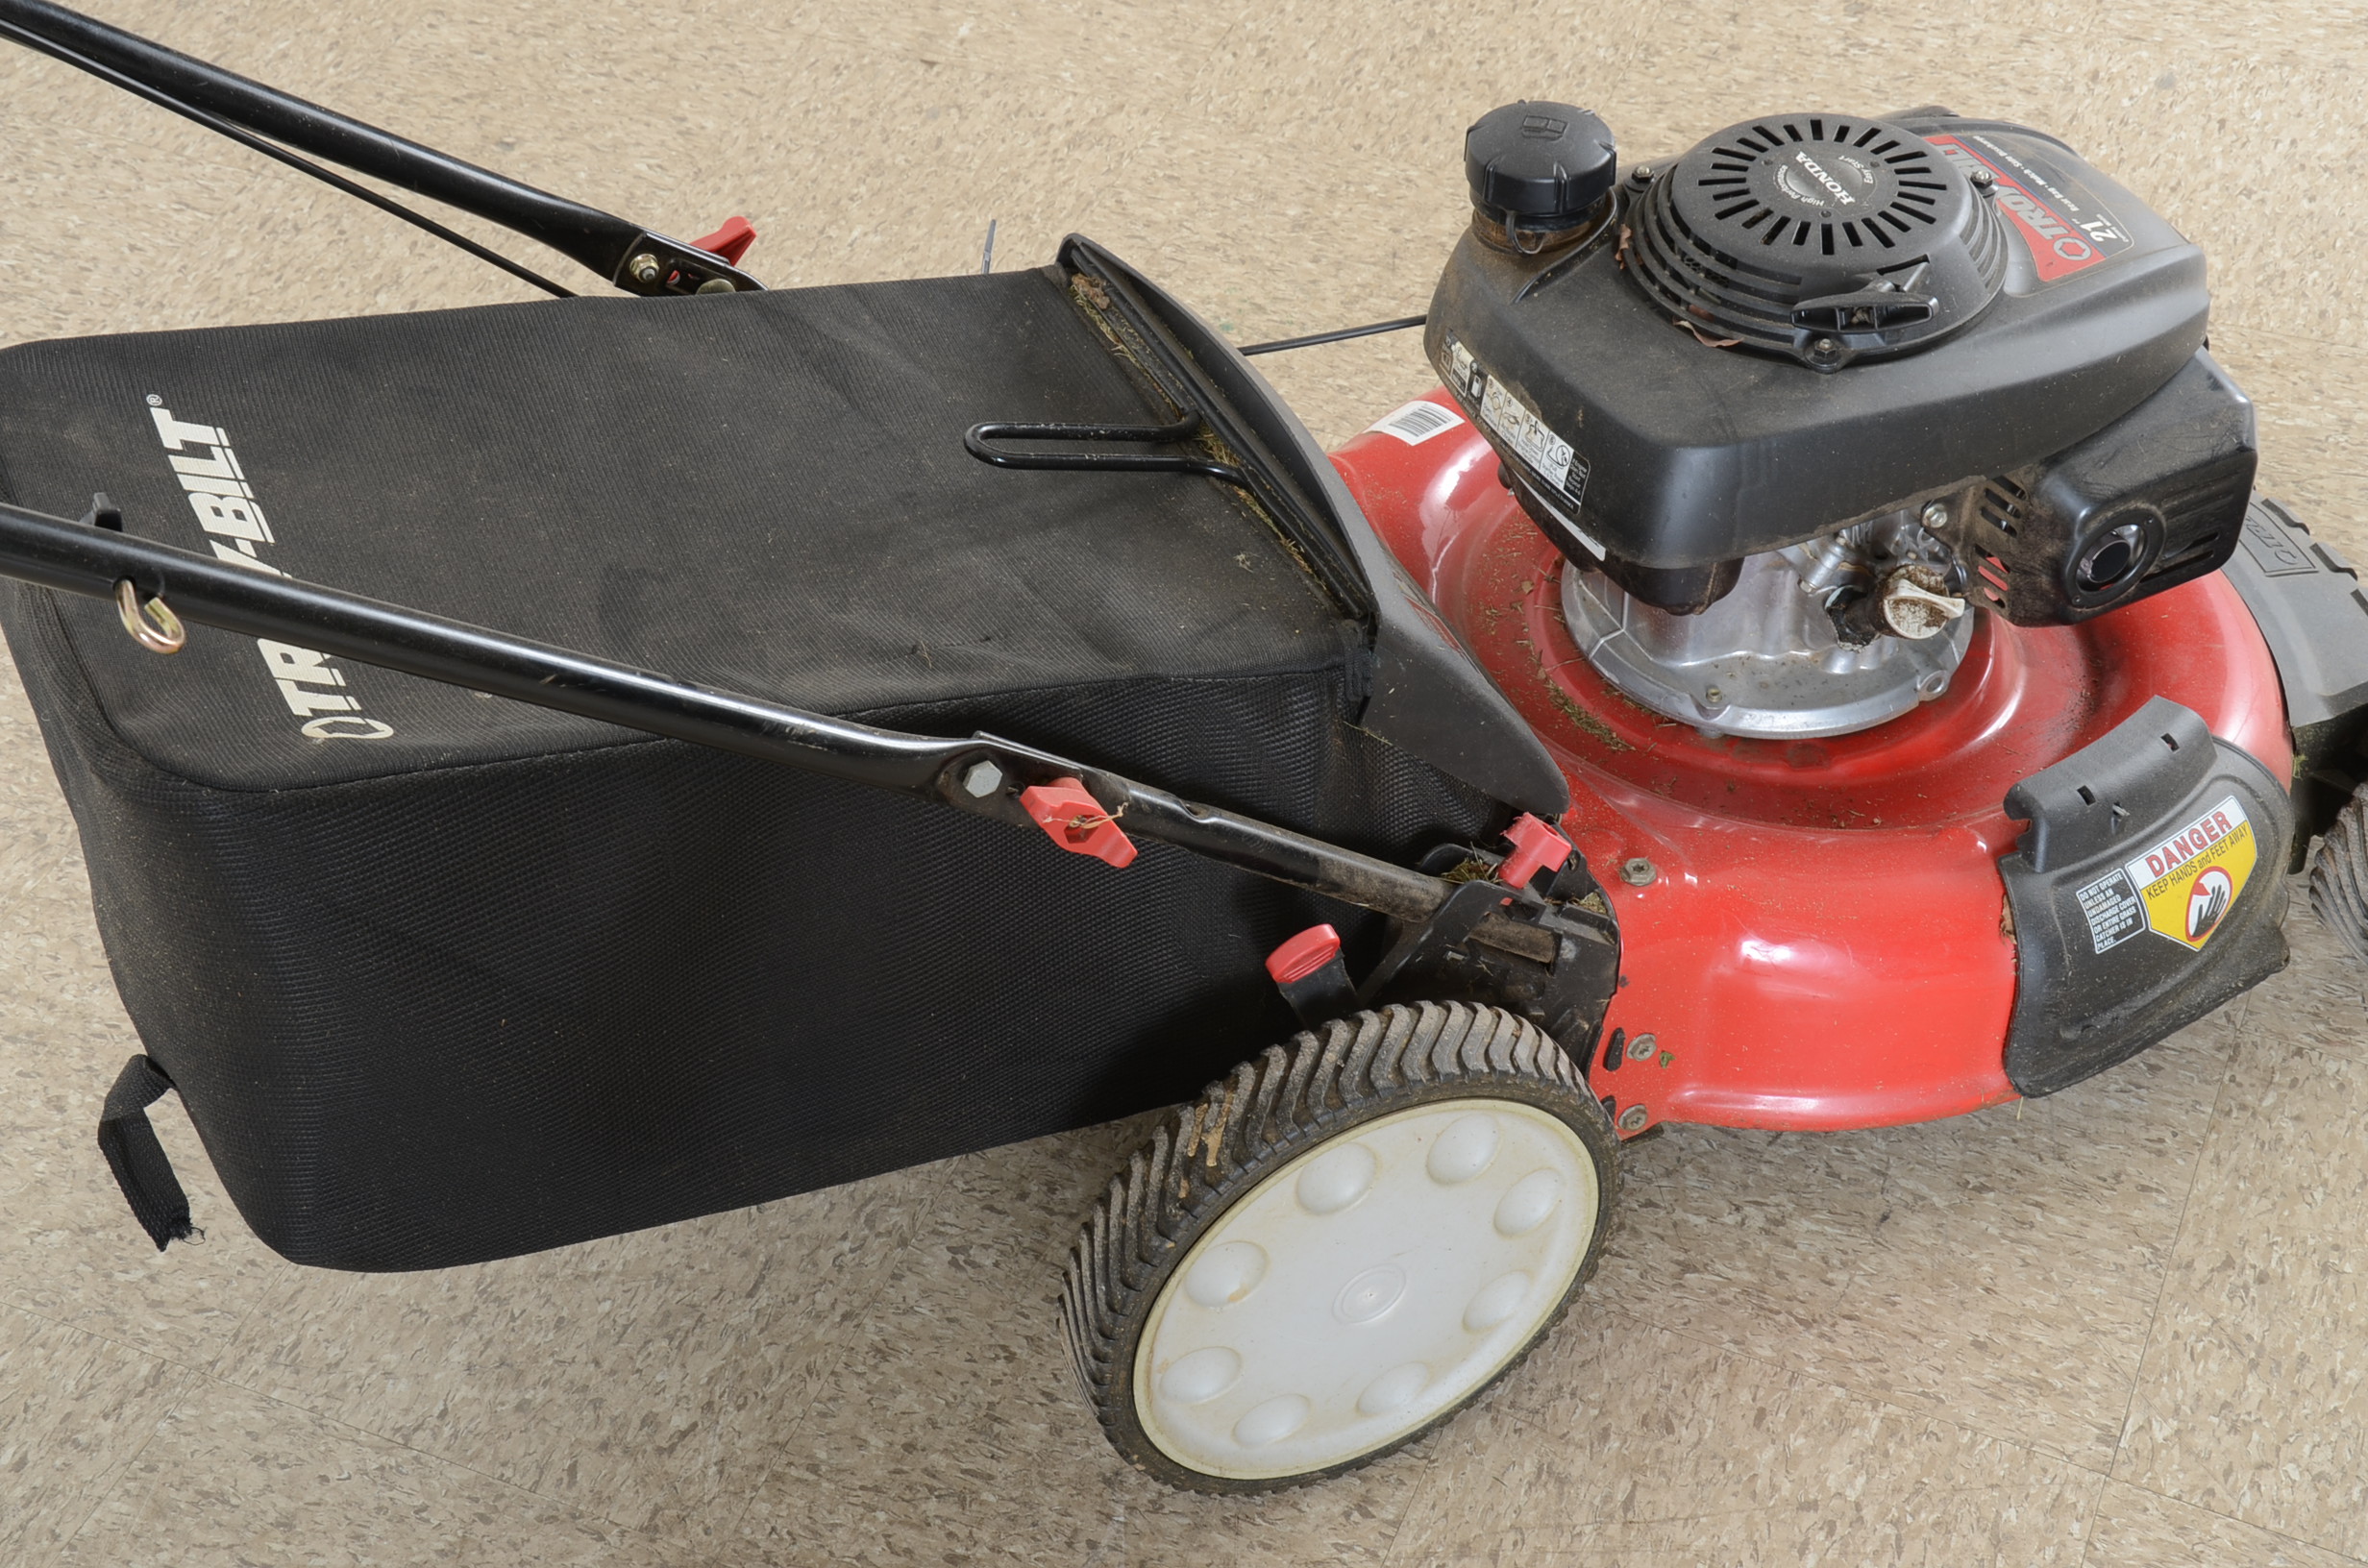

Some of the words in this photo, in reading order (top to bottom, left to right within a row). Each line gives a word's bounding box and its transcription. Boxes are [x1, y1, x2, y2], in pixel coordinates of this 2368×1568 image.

[1838, 155, 1863, 170] Start
[1795, 151, 1856, 206] HONDA
[1862, 168, 1874, 184] Easy
[2024, 168, 2047, 185] Mulch
[1801, 196, 1825, 207] High
[2048, 187, 2063, 199] Bag
[2145, 811, 2232, 878] DANGER
[2146, 879, 2169, 900] KEEP
[2169, 860, 2198, 887] HANDS
[2197, 852, 2212, 869] and
[2210, 841, 2230, 860] FEET
[2229, 824, 2248, 847] AWAY
[2079, 892, 2089, 901] DO
[2087, 885, 2100, 896] NOT
[2099, 872, 2123, 890] OPERATE
[2084, 893, 2106, 909] UNLESS
[2105, 888, 2114, 897] AN
[2087, 894, 2122, 918] UNDAMAGED
[2090, 905, 2120, 925] DISCHARGE
[2119, 895, 2136, 910] COVER
[2094, 924, 2102, 934] OR
[2102, 915, 2120, 929] ENTIRE
[2119, 905, 2136, 920] GRASS
[2095, 924, 2120, 942] CATCHER
[2119, 920, 2126, 930] IS
[2126, 917, 2134, 926] IN
